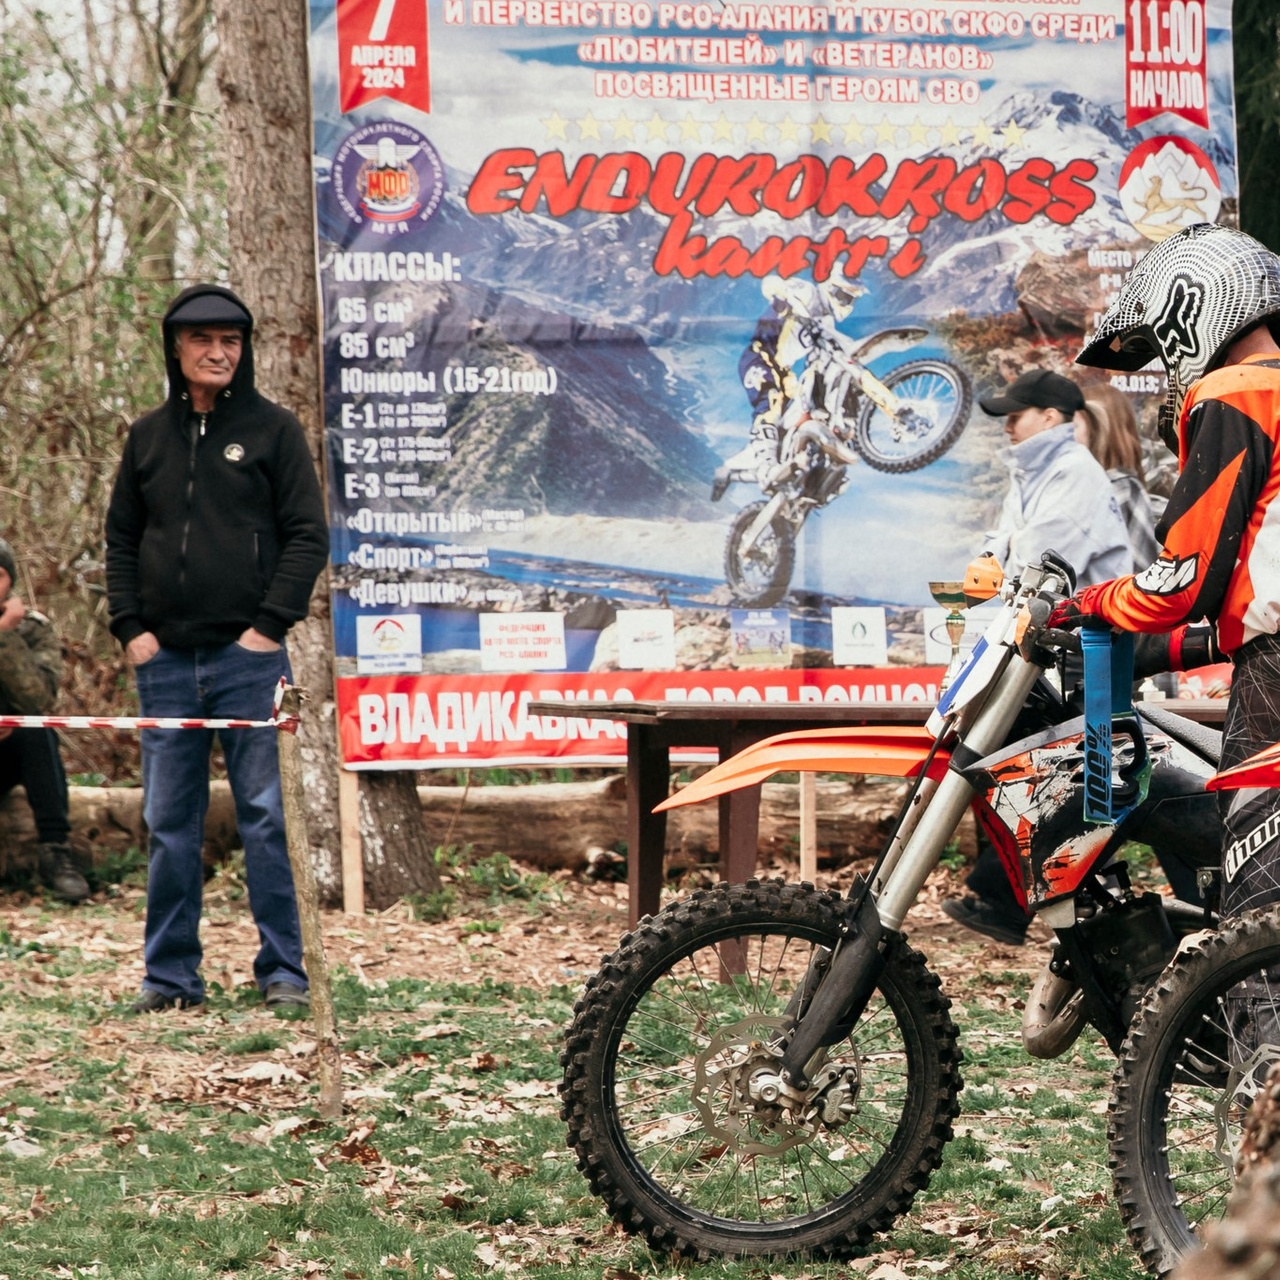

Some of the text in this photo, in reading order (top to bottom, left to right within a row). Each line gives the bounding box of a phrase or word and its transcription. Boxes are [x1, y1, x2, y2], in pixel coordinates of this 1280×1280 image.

[658, 3, 829, 32] РСО-АЛАНИЯ
[836, 7, 856, 33] И
[862, 8, 947, 36] КУБОК
[952, 10, 1025, 38] СКФО
[1030, 14, 1116, 44] СРЕДИ
[351, 45, 416, 66] АПРЕЛЯ
[579, 34, 994, 70] «ЛЮБИТЕЛЕЙ» И «ВЕТЕРАНОВ»
[361, 68, 405, 89] 2024
[594, 71, 981, 105] ПОСВЯЩЕННЫЕ ГЕРОЯМ СВО
[1130, 70, 1204, 109] НАЧАЛО
[466, 148, 1098, 225] ENDUROKROSS
[652, 211, 928, 282] kantri
[1088, 249, 1132, 268] МЕСТО
[334, 251, 461, 281] КЛАССЫ:
[338, 297, 366, 323] 65
[340, 332, 369, 358] 85
[341, 366, 557, 396] Юниоры (15-21год)
[347, 506, 482, 536] «Открытый»
[348, 543, 433, 572] «Спорт»
[349, 577, 468, 607] «Девушки»
[1086, 721, 1111, 819] 100%
